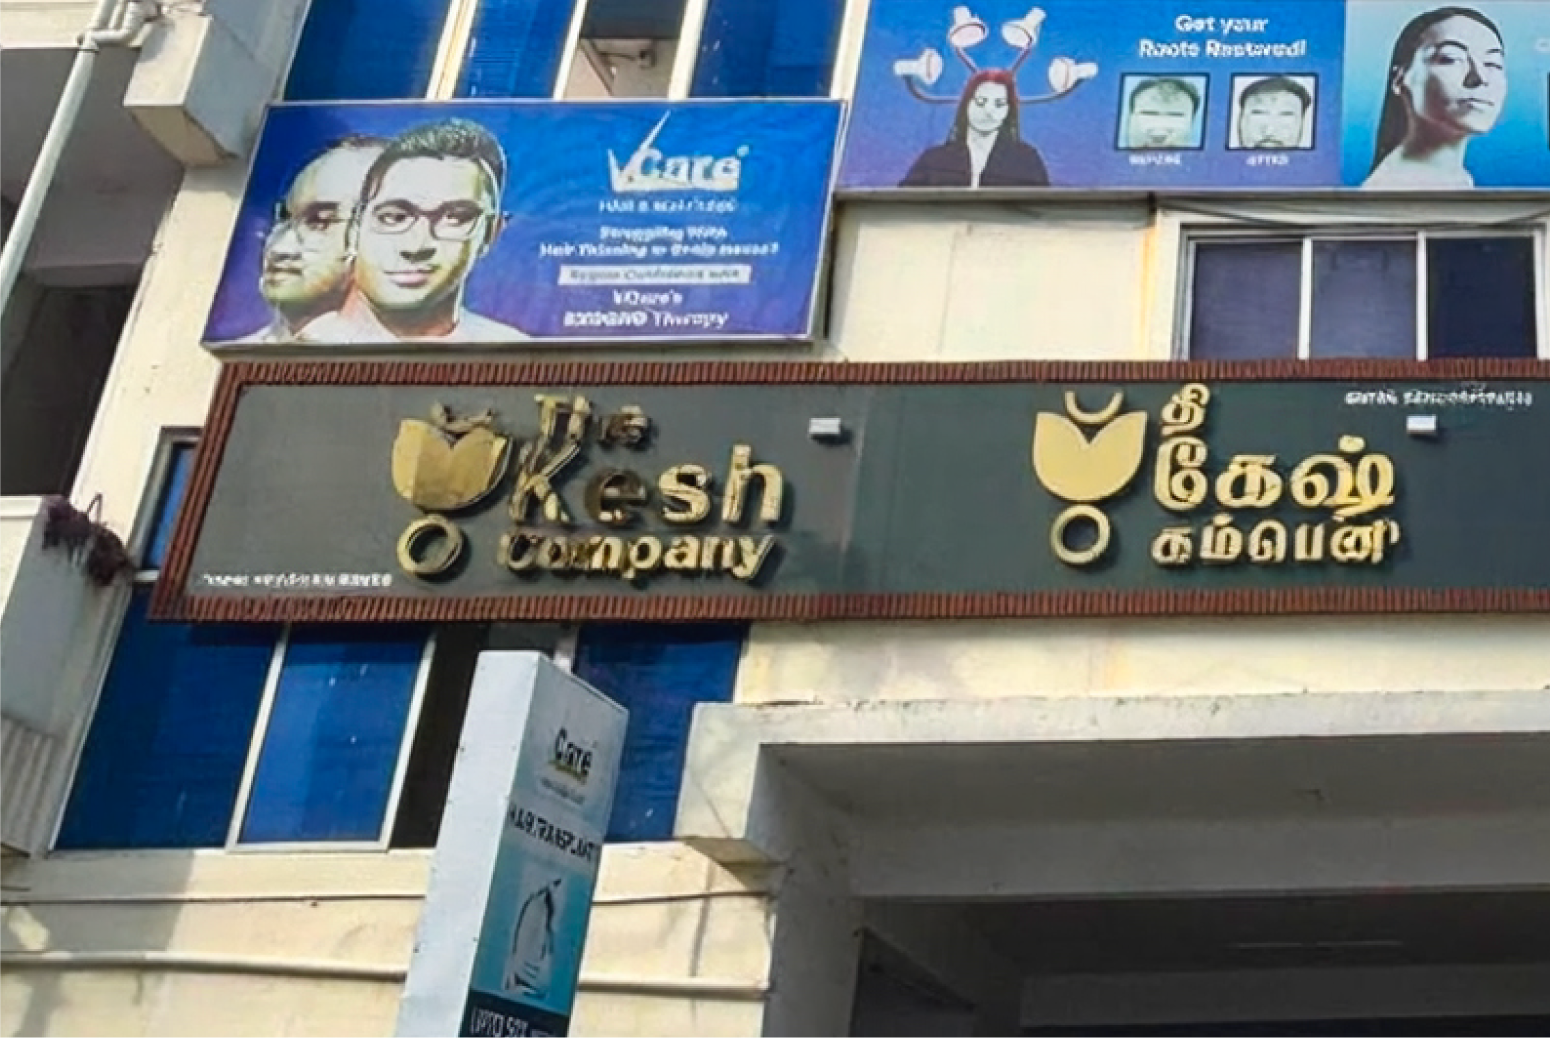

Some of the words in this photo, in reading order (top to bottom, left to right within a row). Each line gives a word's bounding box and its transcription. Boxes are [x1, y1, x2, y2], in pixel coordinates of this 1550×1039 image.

[1175, 14, 1216, 32] Get
[1220, 17, 1269, 36] your
[509, 440, 783, 523] Kesh
